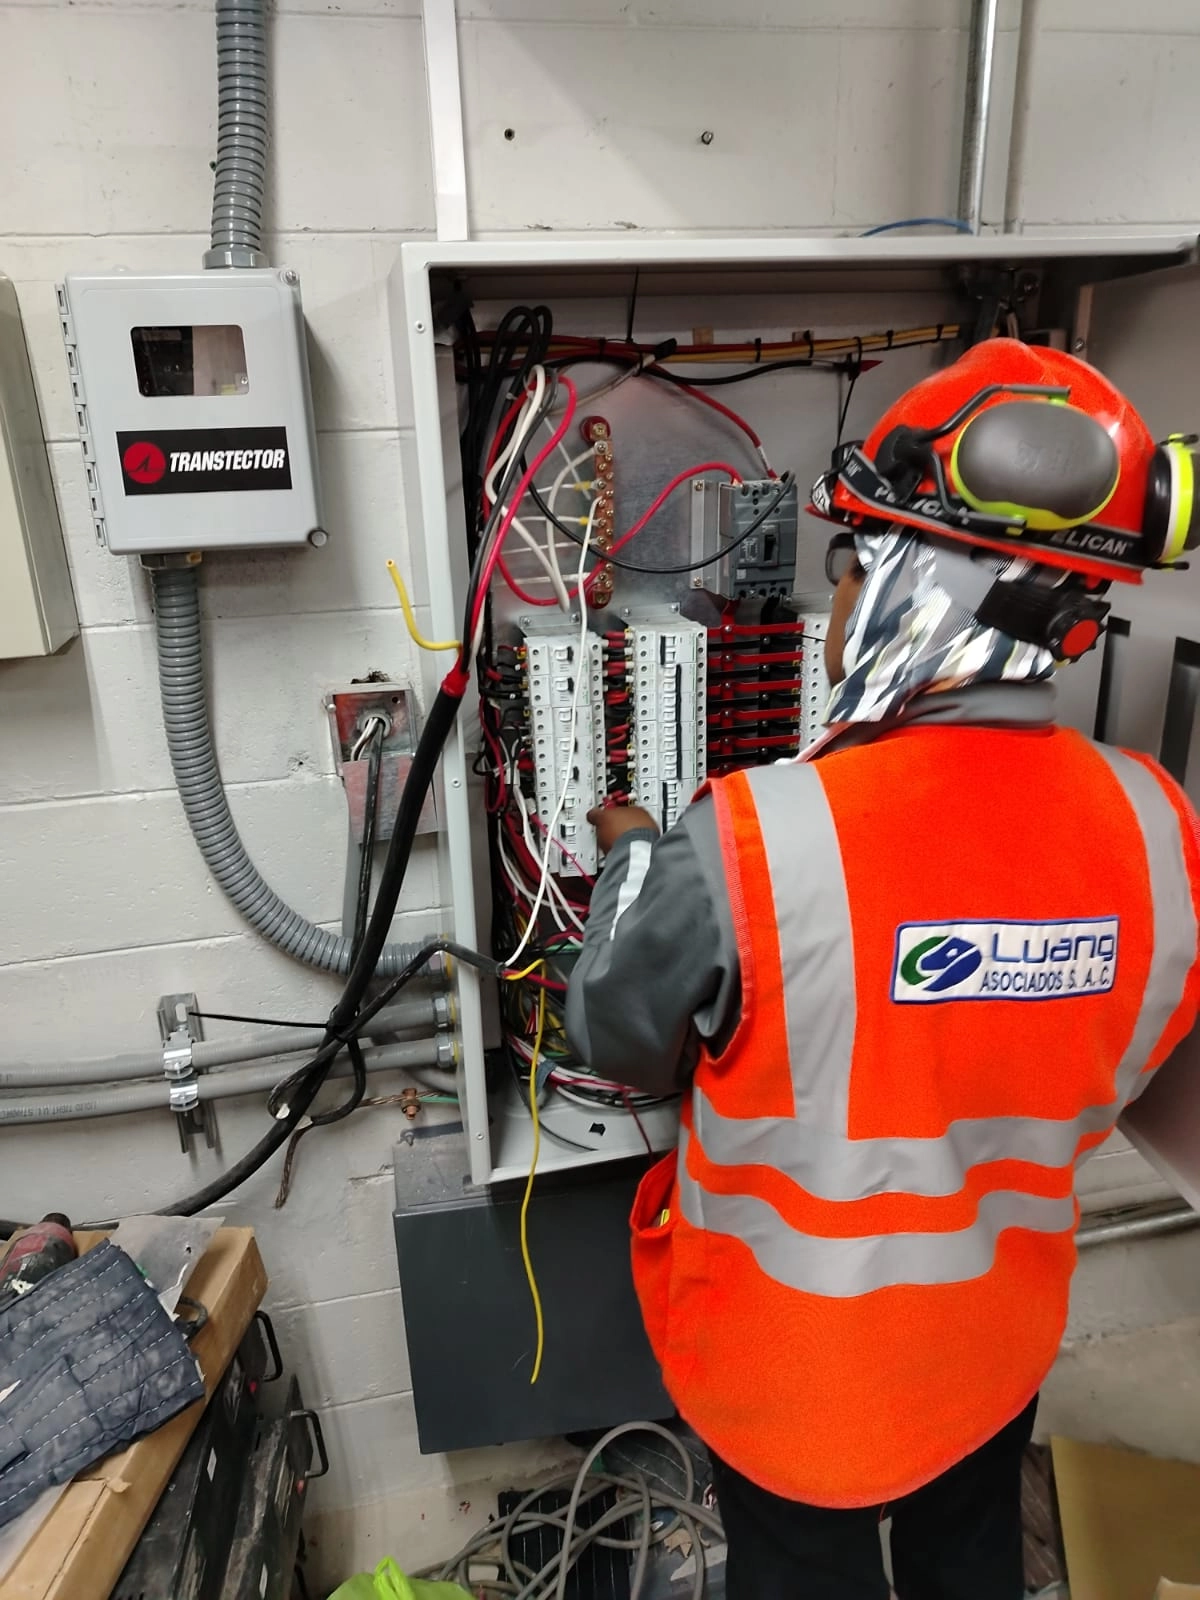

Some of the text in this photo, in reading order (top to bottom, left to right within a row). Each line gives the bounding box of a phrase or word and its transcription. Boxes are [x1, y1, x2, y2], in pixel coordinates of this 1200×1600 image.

[170, 449, 285, 472] TRANSTECTOR
[992, 932, 1114, 964] Luang
[980, 969, 1063, 993] ASOCIADOS
